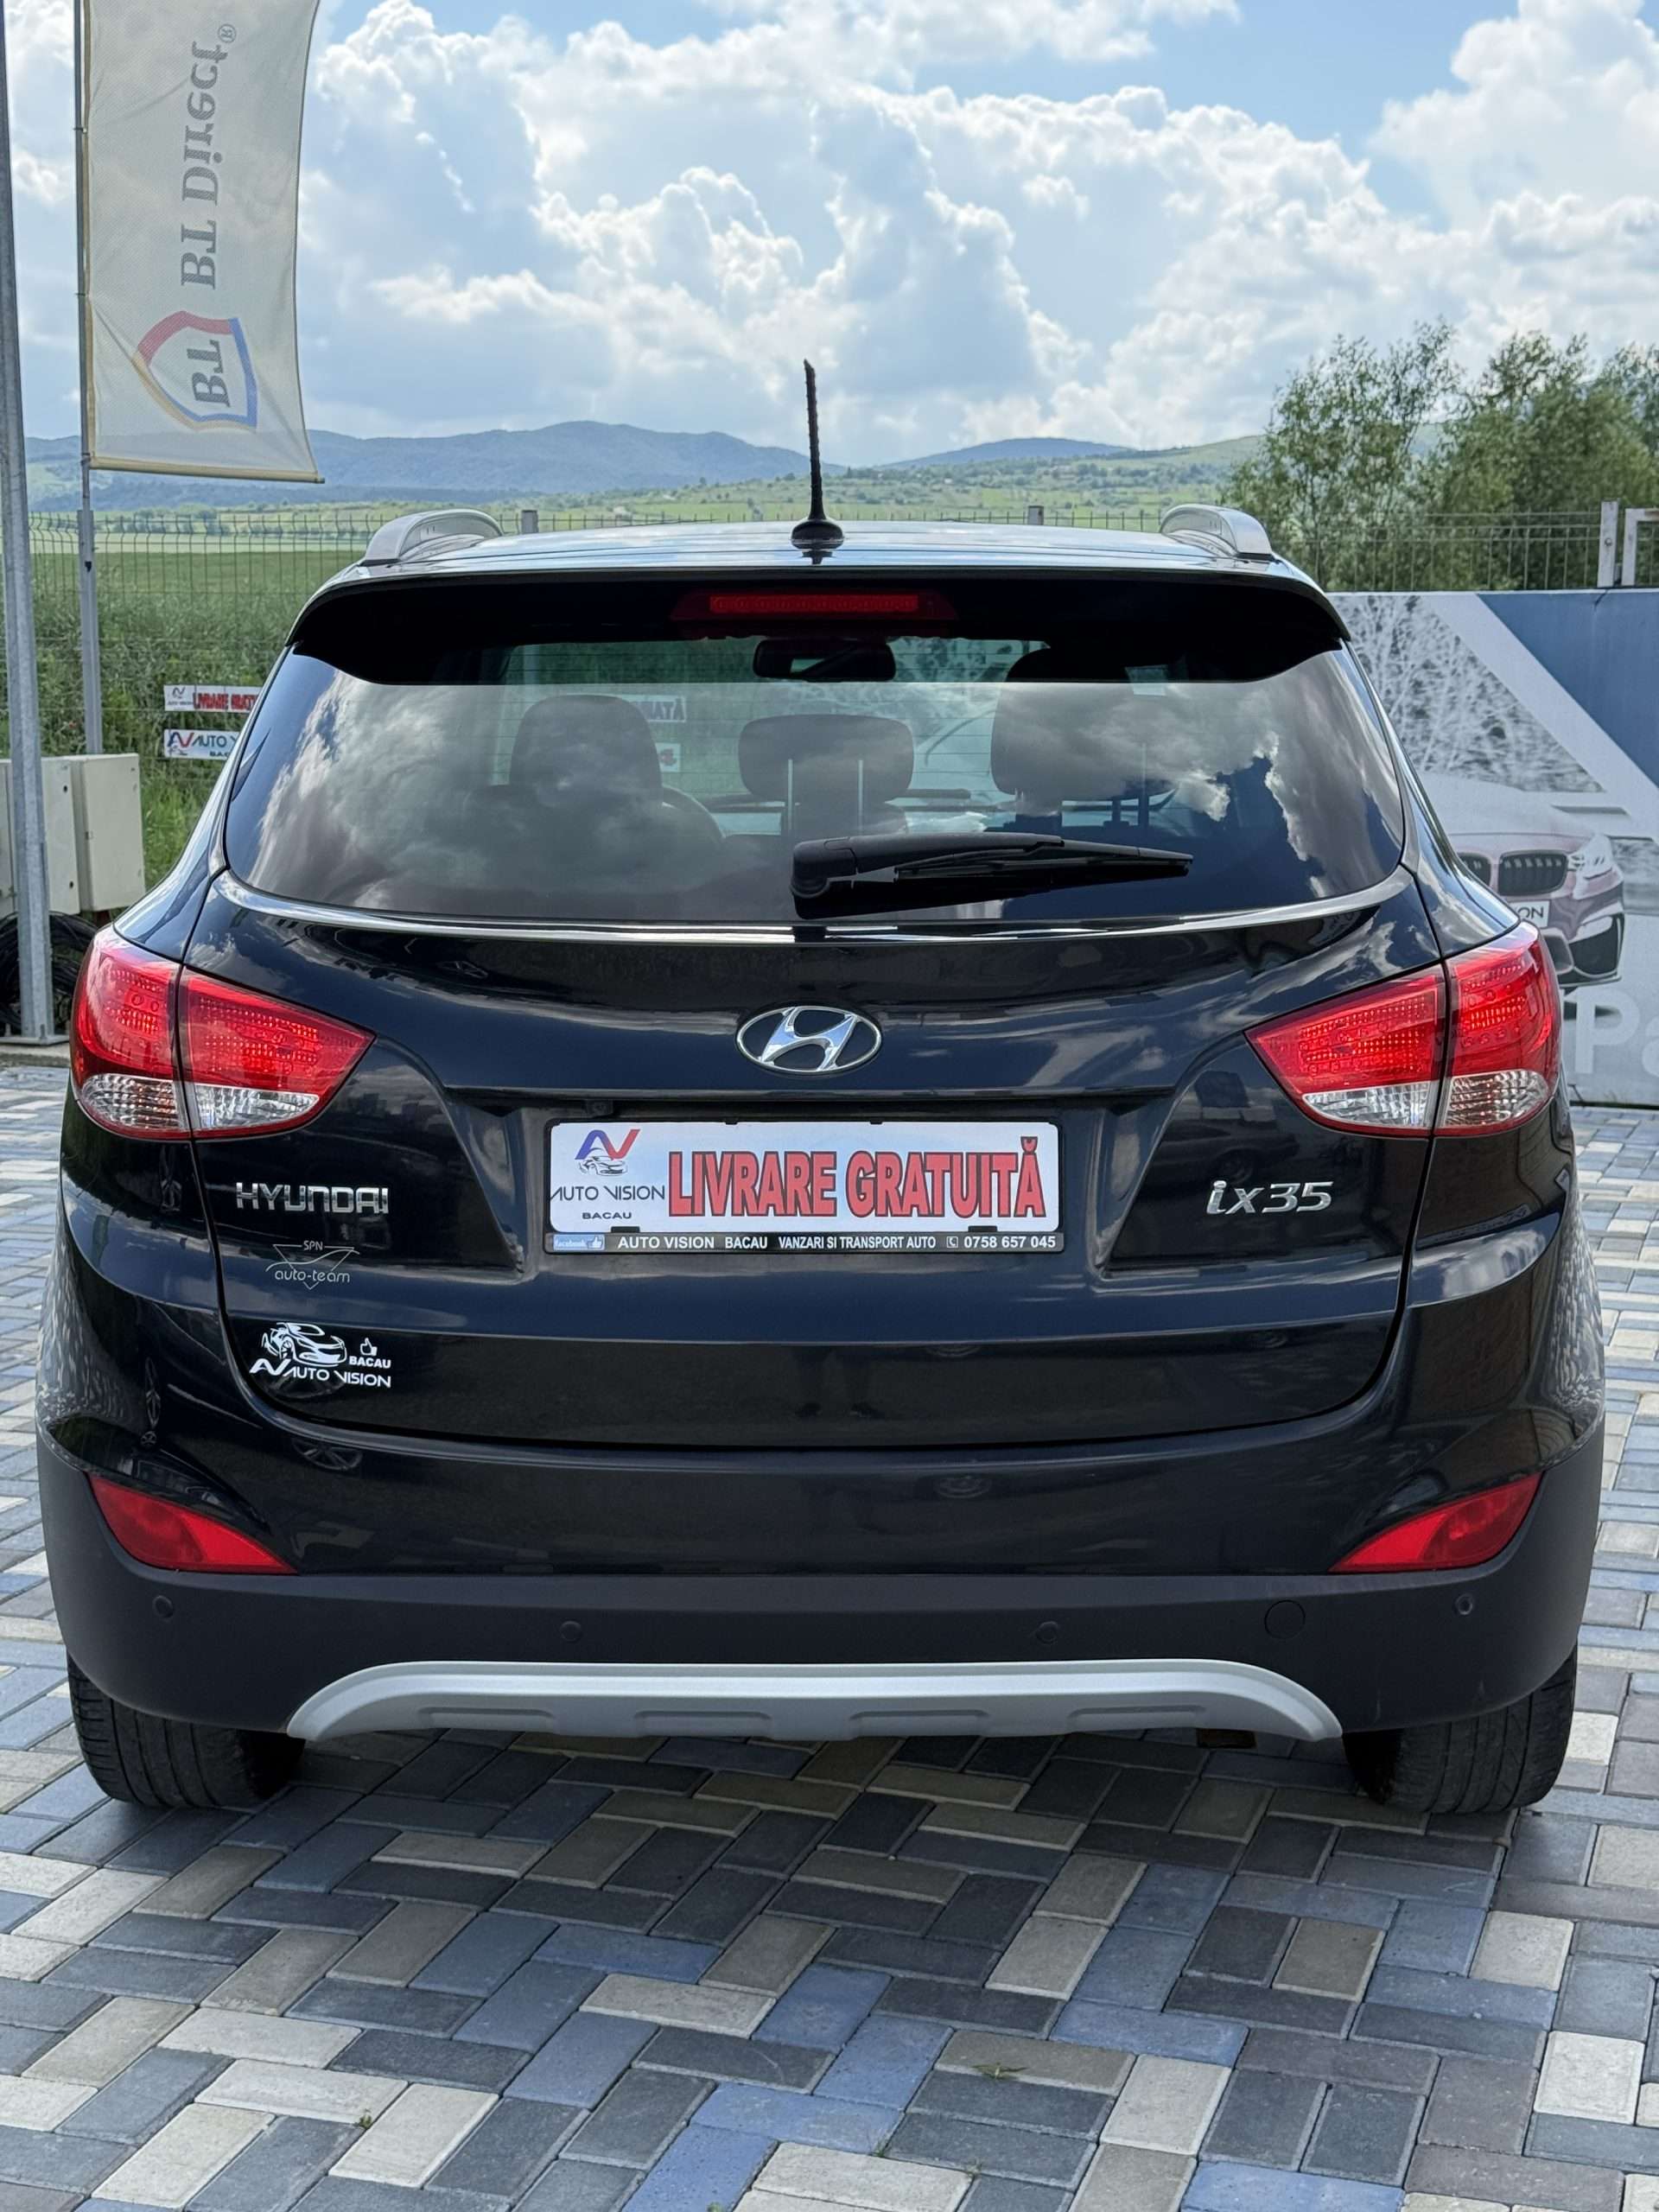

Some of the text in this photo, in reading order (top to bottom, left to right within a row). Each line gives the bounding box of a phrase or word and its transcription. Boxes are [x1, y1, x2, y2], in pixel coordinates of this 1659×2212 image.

[192, 735, 227, 747] AUTO
[669, 1136, 1046, 1218] LIVRARE GRATUITĂ
[236, 1182, 389, 1214] HYUNDAI
[550, 1185, 665, 1201] AUTO VISION
[582, 1211, 632, 1220] BACAU
[302, 1240, 324, 1251] SPN
[617, 1236, 1056, 1249] AUTO VISION BACAU VANZARI SI TRANSPORT AUTO 0758 657 045
[274, 1268, 351, 1283] auto-team
[348, 1356, 391, 1369] BACAU
[282, 1367, 330, 1381] AUTO
[333, 1370, 391, 1389] VISION
